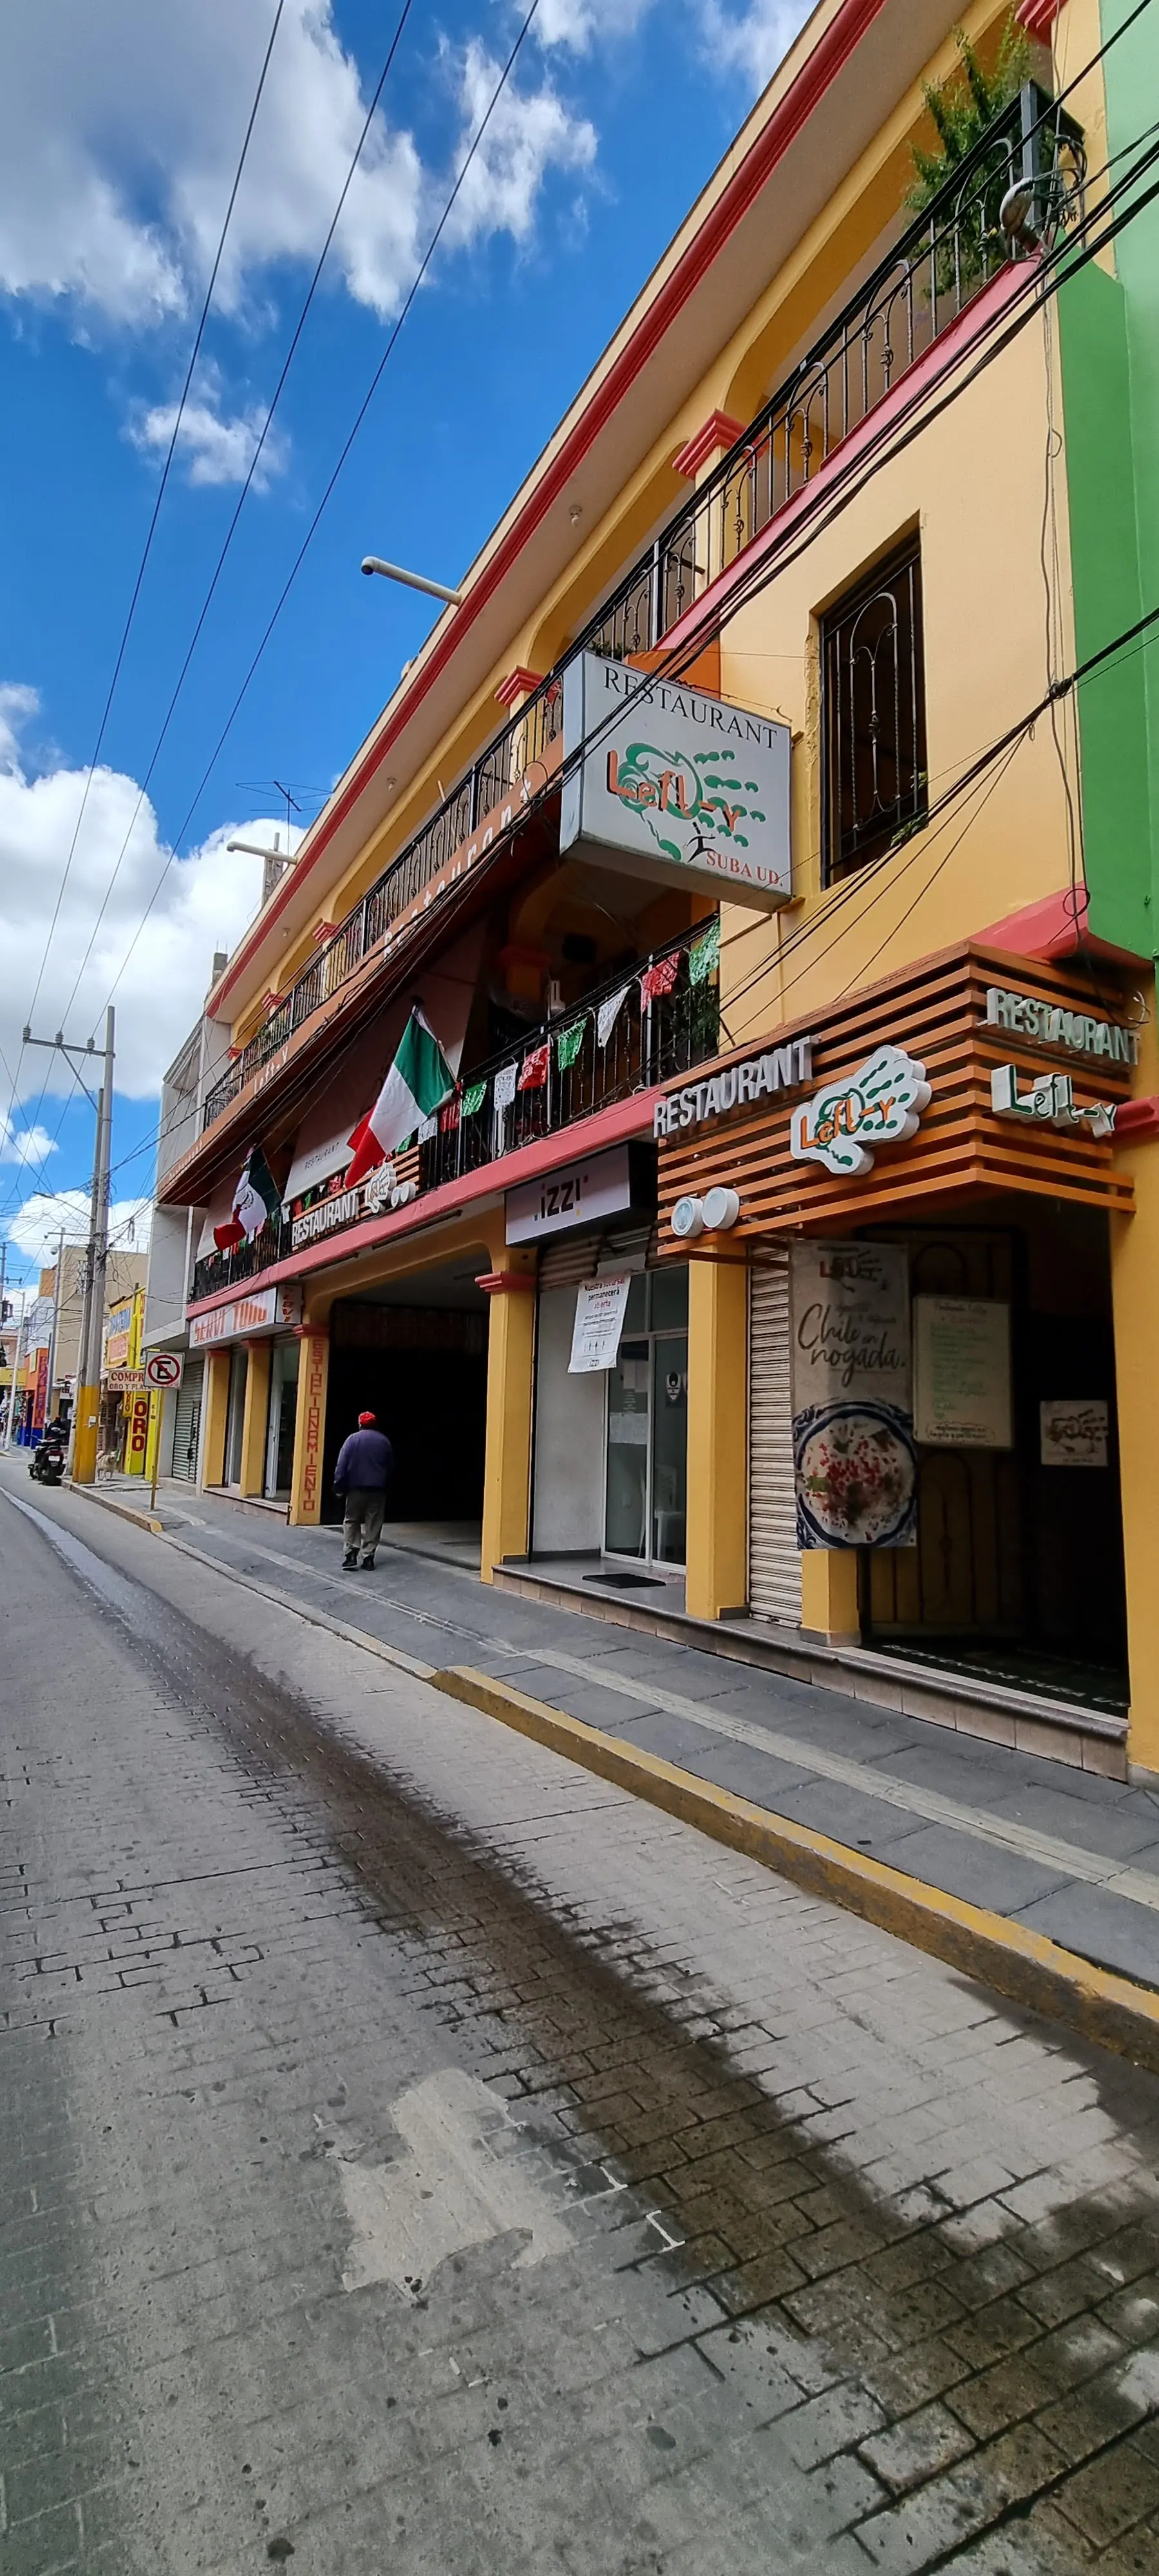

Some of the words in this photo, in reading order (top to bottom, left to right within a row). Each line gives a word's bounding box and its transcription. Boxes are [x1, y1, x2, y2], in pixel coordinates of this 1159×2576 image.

[603, 666, 778, 750] RESTAURANT
[706, 850, 752, 878] SUBA
[757, 866, 784, 887] UD.
[986, 987, 1142, 1066] RESTAURANT
[652, 1034, 821, 1139] RESTAURANT
[292, 1189, 359, 1245] RESTAURANT
[798, 1303, 858, 1350] Chile
[861, 1336, 880, 1346] en
[131, 1401, 147, 1452] ORO
[303, 1340, 325, 1511] ESTACIONAMIENTO
